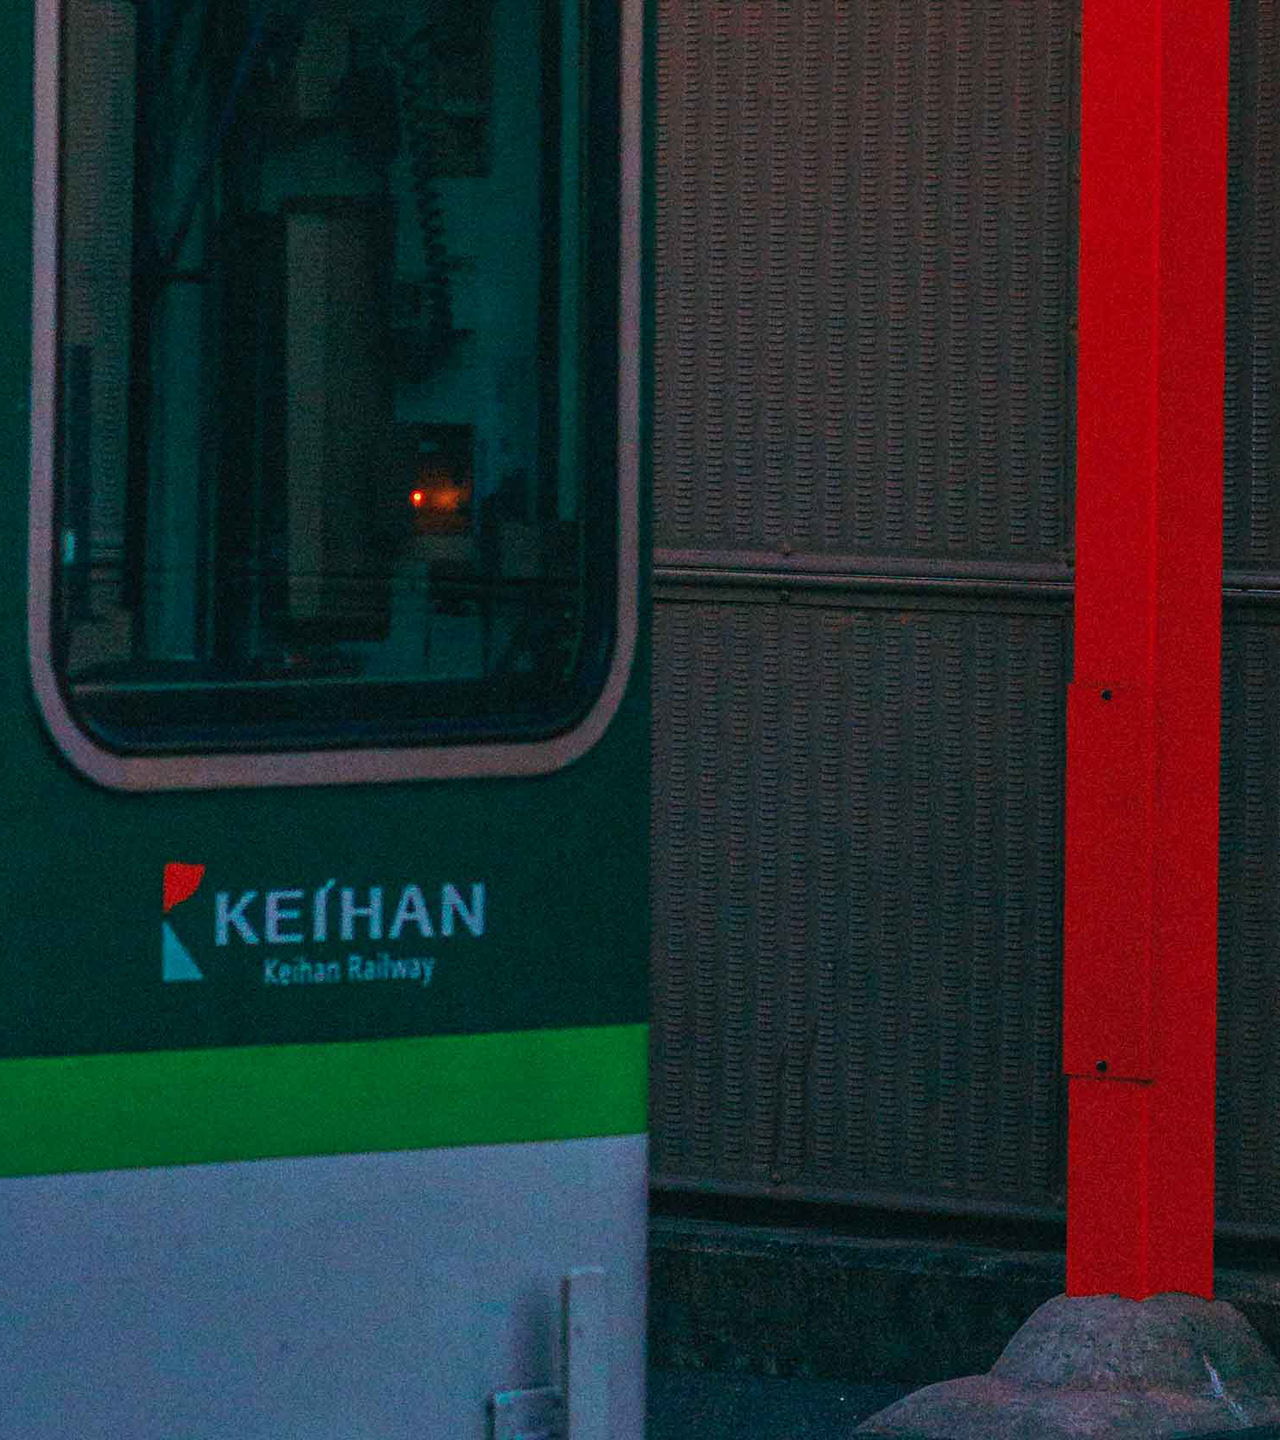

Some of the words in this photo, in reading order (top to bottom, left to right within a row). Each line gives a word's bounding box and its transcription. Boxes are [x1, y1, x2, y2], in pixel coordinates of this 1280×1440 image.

[214, 878, 486, 946] KEIHAN
[264, 956, 341, 986] Keihan
[347, 952, 436, 987] Railway
